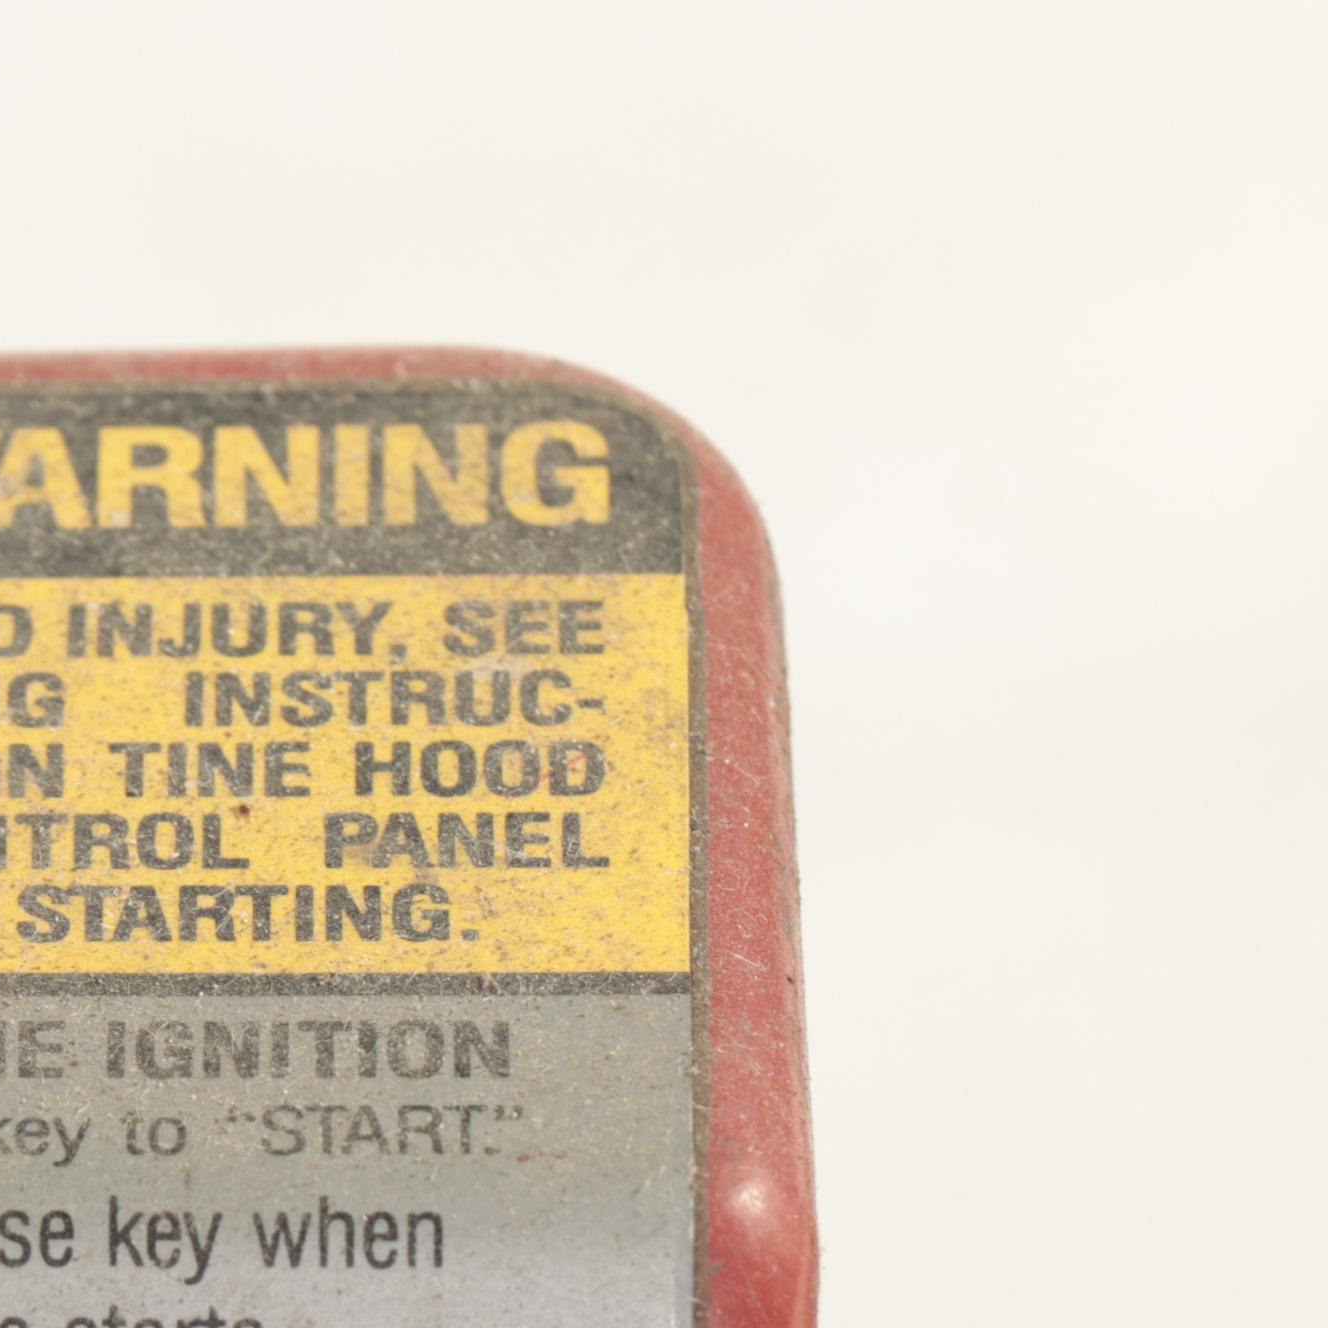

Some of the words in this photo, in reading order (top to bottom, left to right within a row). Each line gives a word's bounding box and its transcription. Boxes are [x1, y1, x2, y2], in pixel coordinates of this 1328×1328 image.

[442, 598, 604, 654] SEE
[183, 671, 604, 726] INSTRUC-
[109, 743, 309, 797] TINE
[354, 741, 604, 796] HOOD
[323, 812, 610, 867] PANEL
[16, 885, 478, 941] STARTING.
[106, 1021, 511, 1077] IGNITION
[124, 1108, 188, 1155] to
[109, 1197, 220, 1284] key
[255, 1199, 444, 1270] when
